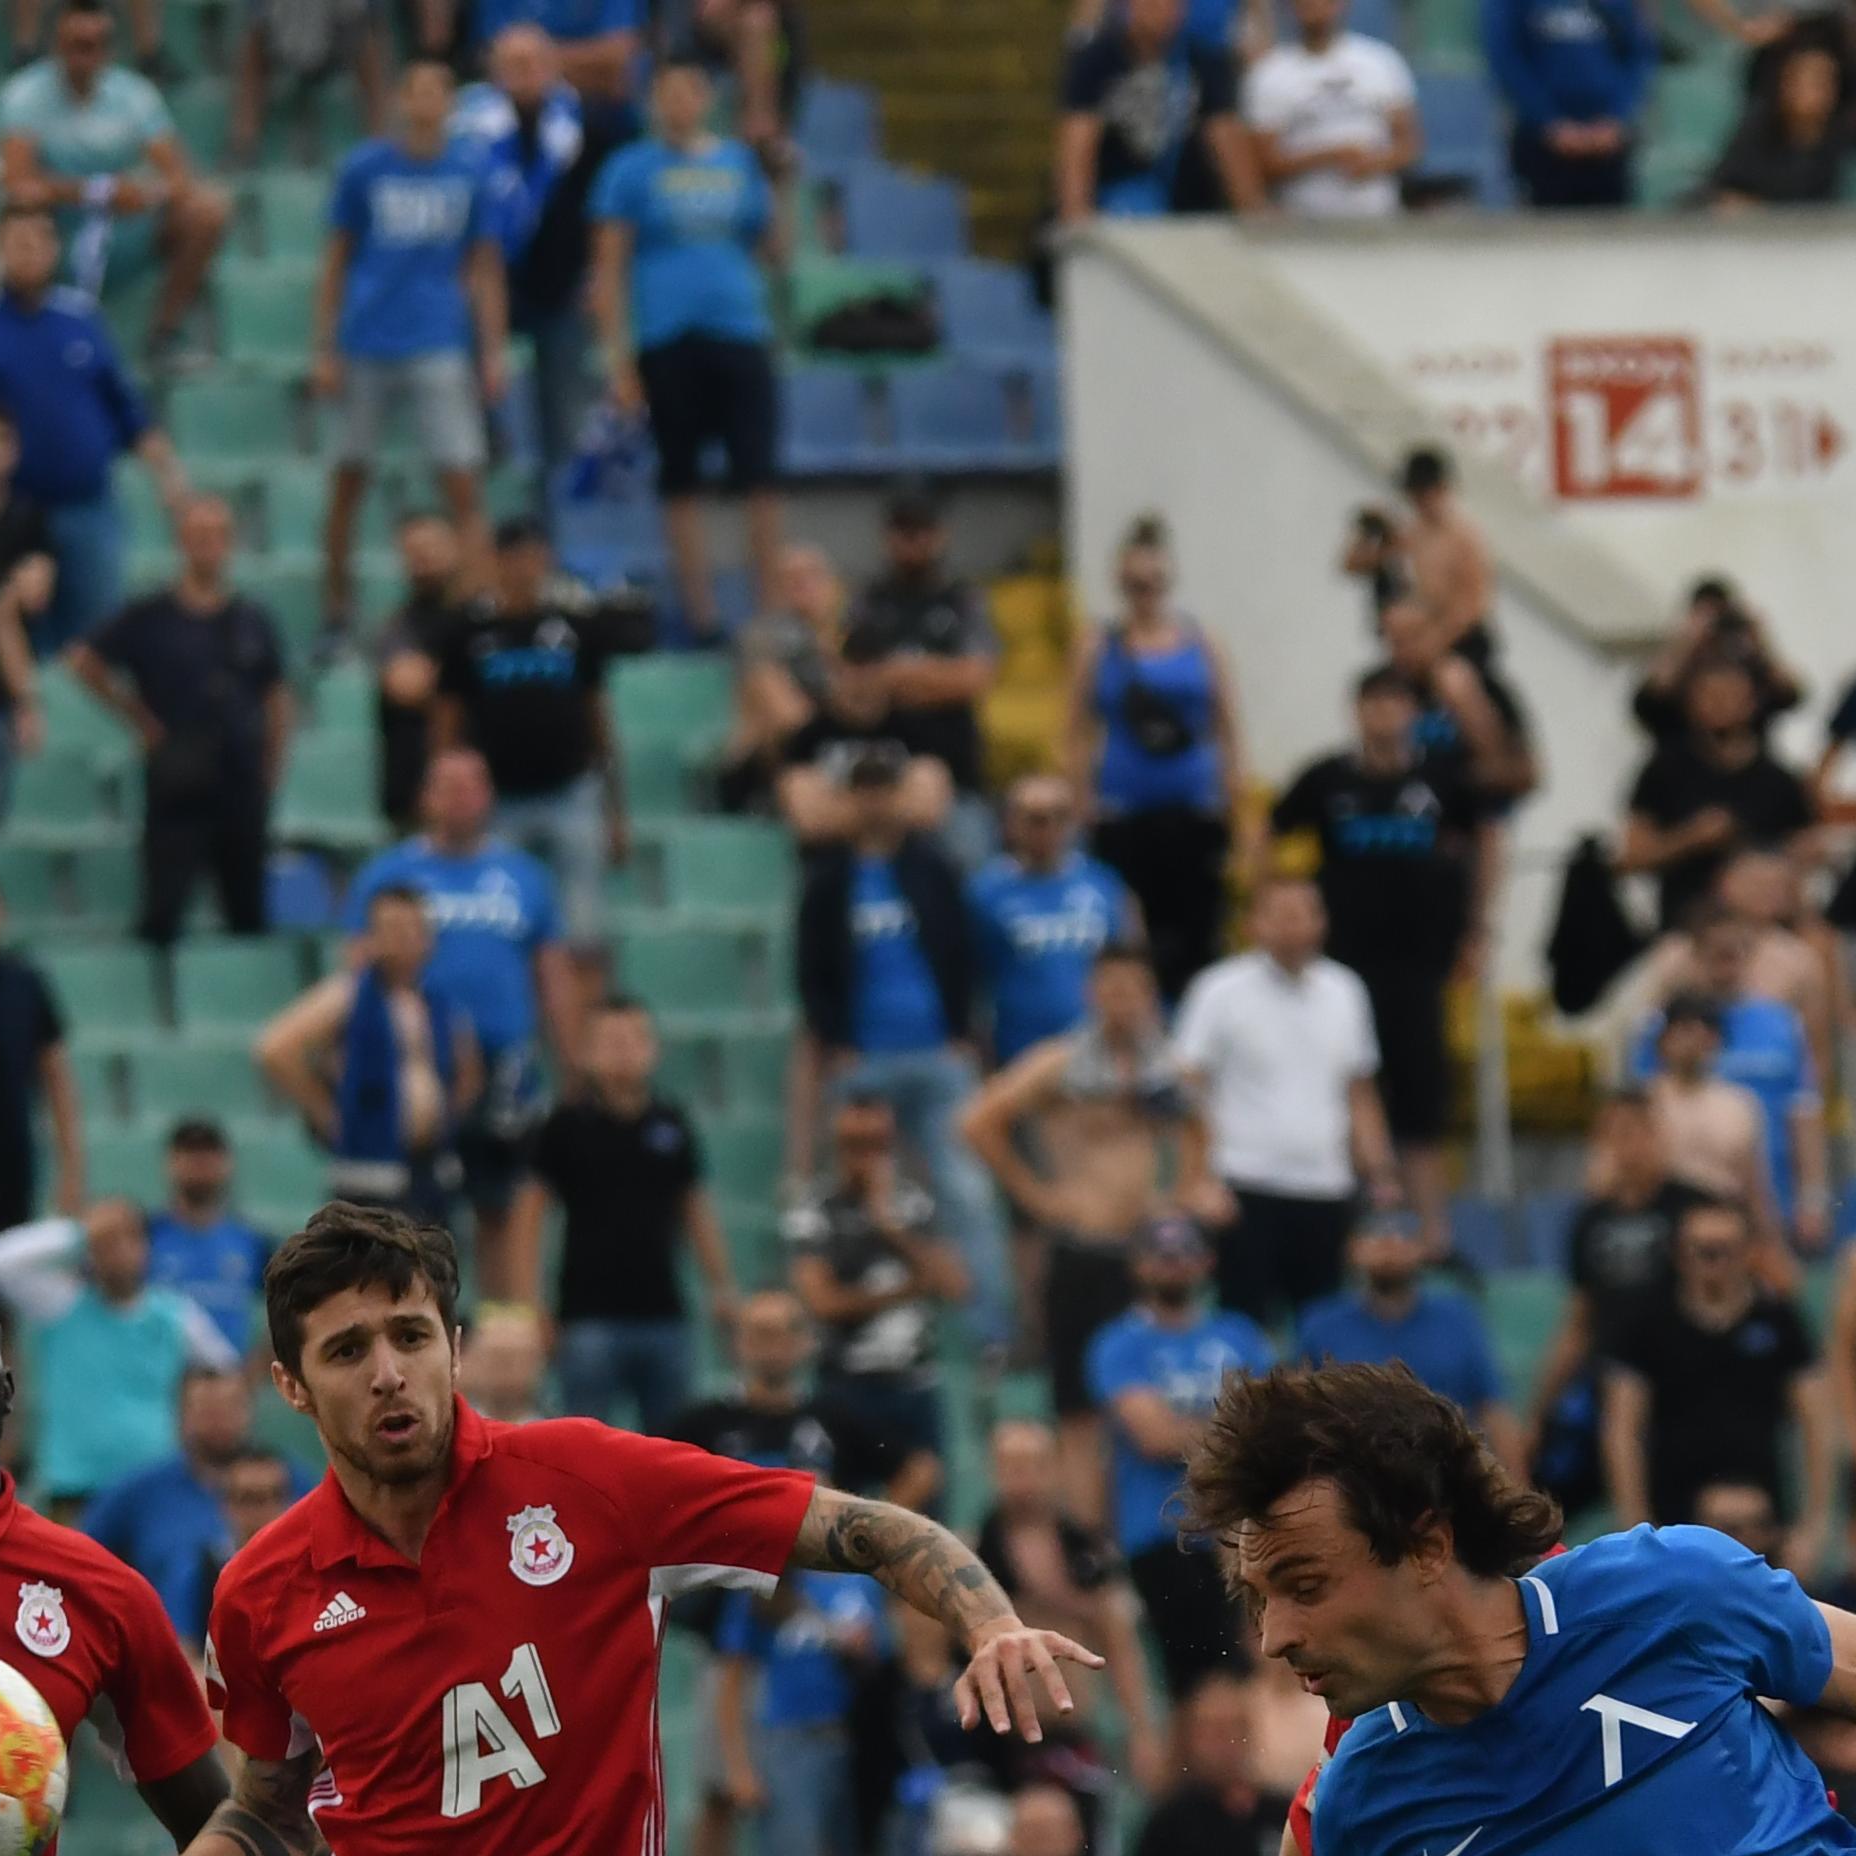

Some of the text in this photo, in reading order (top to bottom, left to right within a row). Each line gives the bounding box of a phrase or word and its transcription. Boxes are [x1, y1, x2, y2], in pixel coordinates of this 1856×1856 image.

[1568, 391, 1691, 484] 14
[313, 1605, 367, 1632] adidas
[441, 1642, 562, 1818] A1
